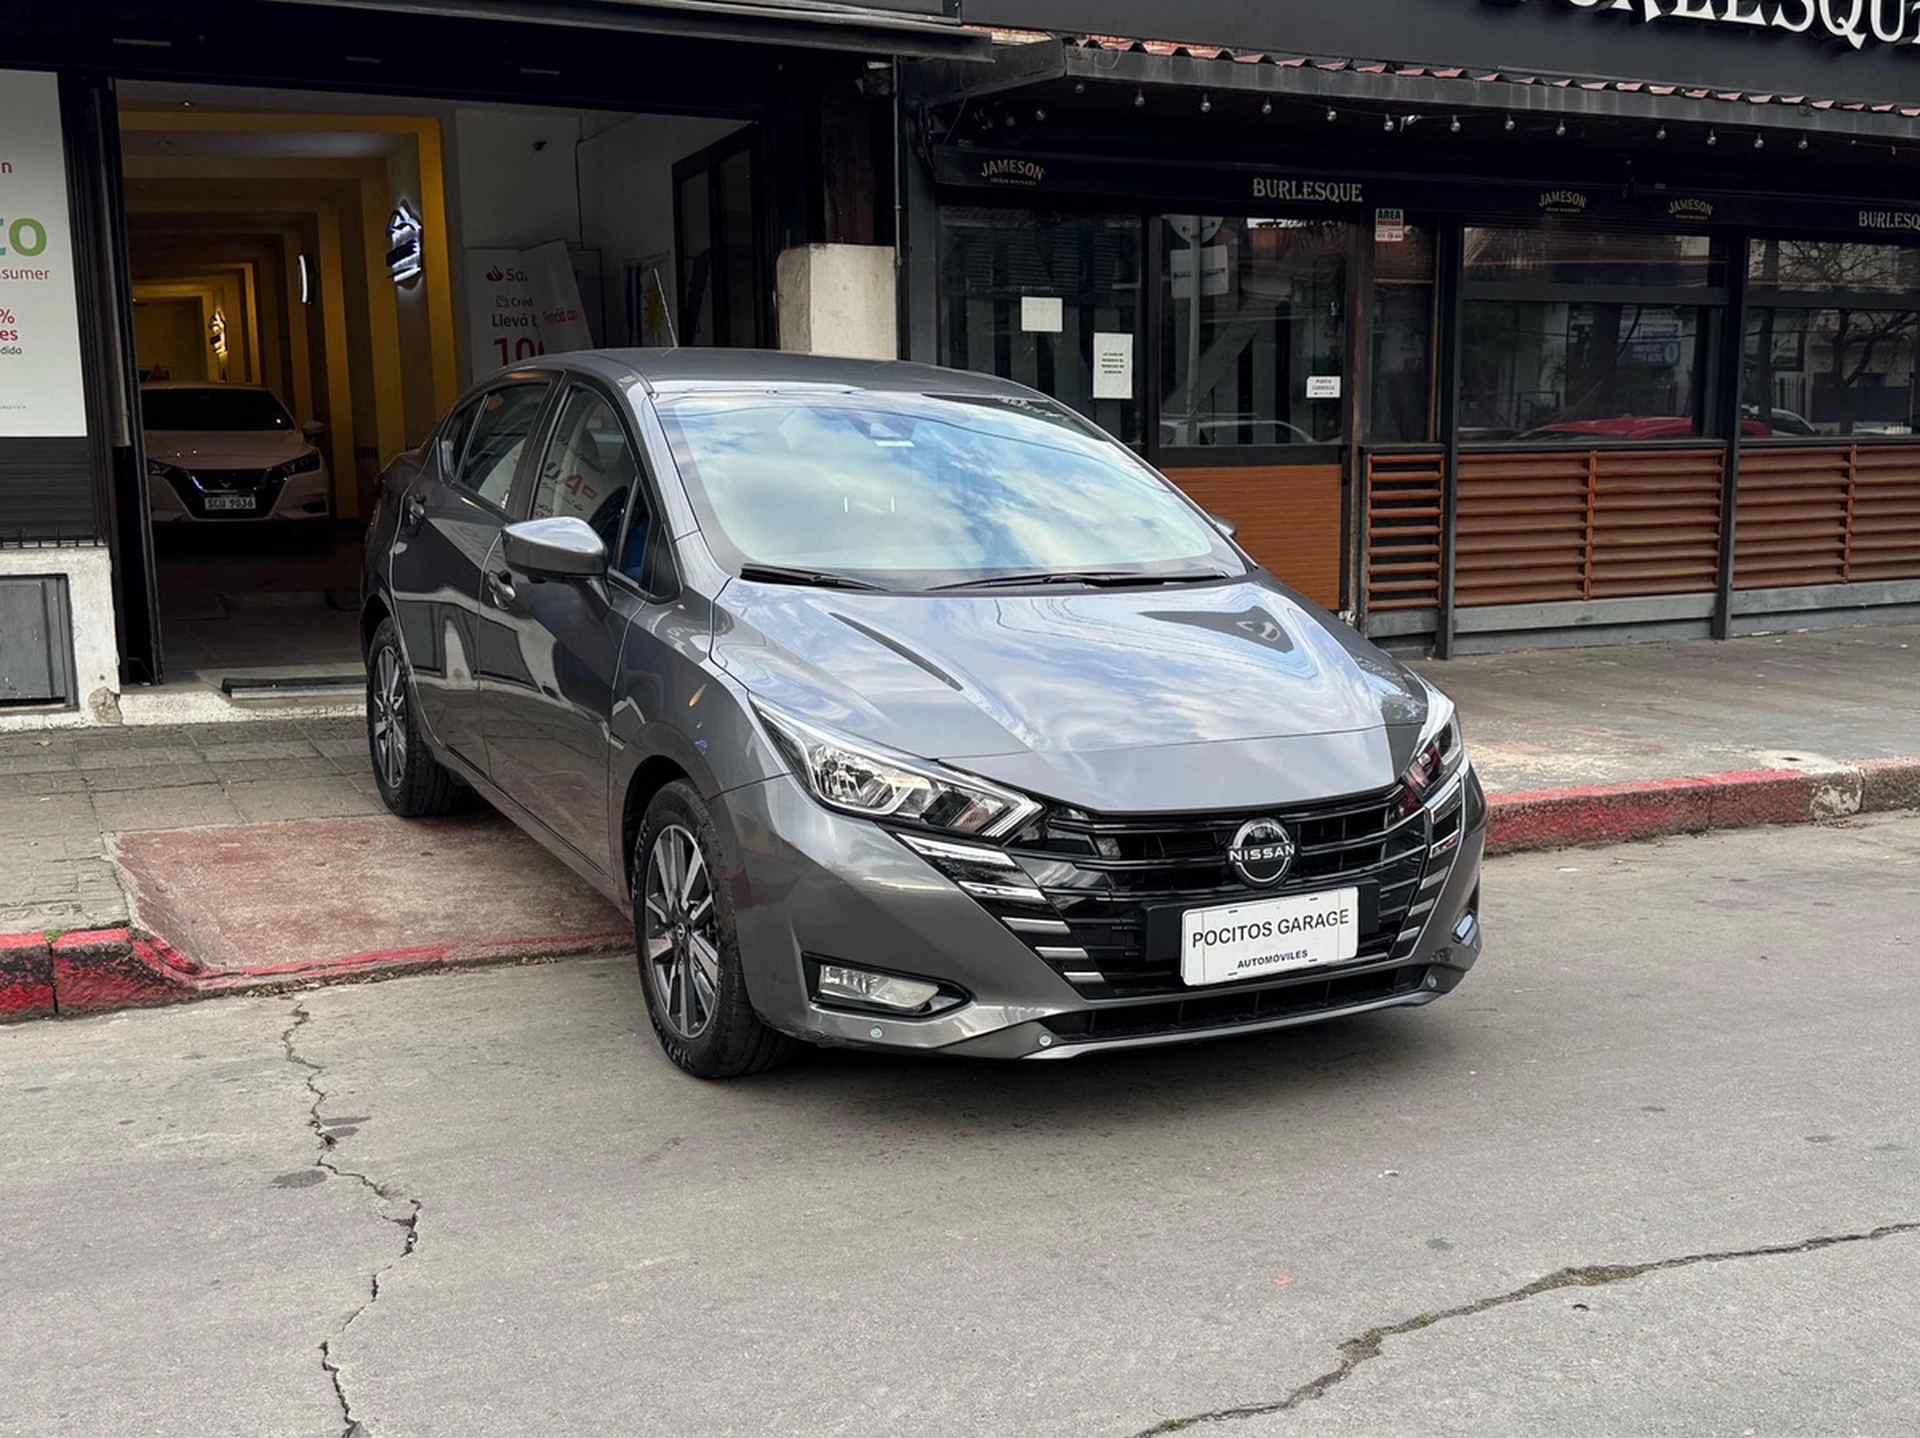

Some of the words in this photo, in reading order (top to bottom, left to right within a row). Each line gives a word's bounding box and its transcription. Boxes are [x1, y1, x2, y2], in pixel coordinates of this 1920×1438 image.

[981, 159, 1043, 180] JAMESON
[1252, 177, 1364, 203] BURLESQUE
[1538, 190, 1588, 208] JAMESON
[1668, 199, 1713, 216] JAMESON
[0, 268, 50, 280] sumer
[492, 313, 528, 327] Llevá
[1229, 844, 1295, 861] NISSAN
[1192, 921, 1273, 948] POCITOS
[1277, 908, 1350, 935] GARAGE
